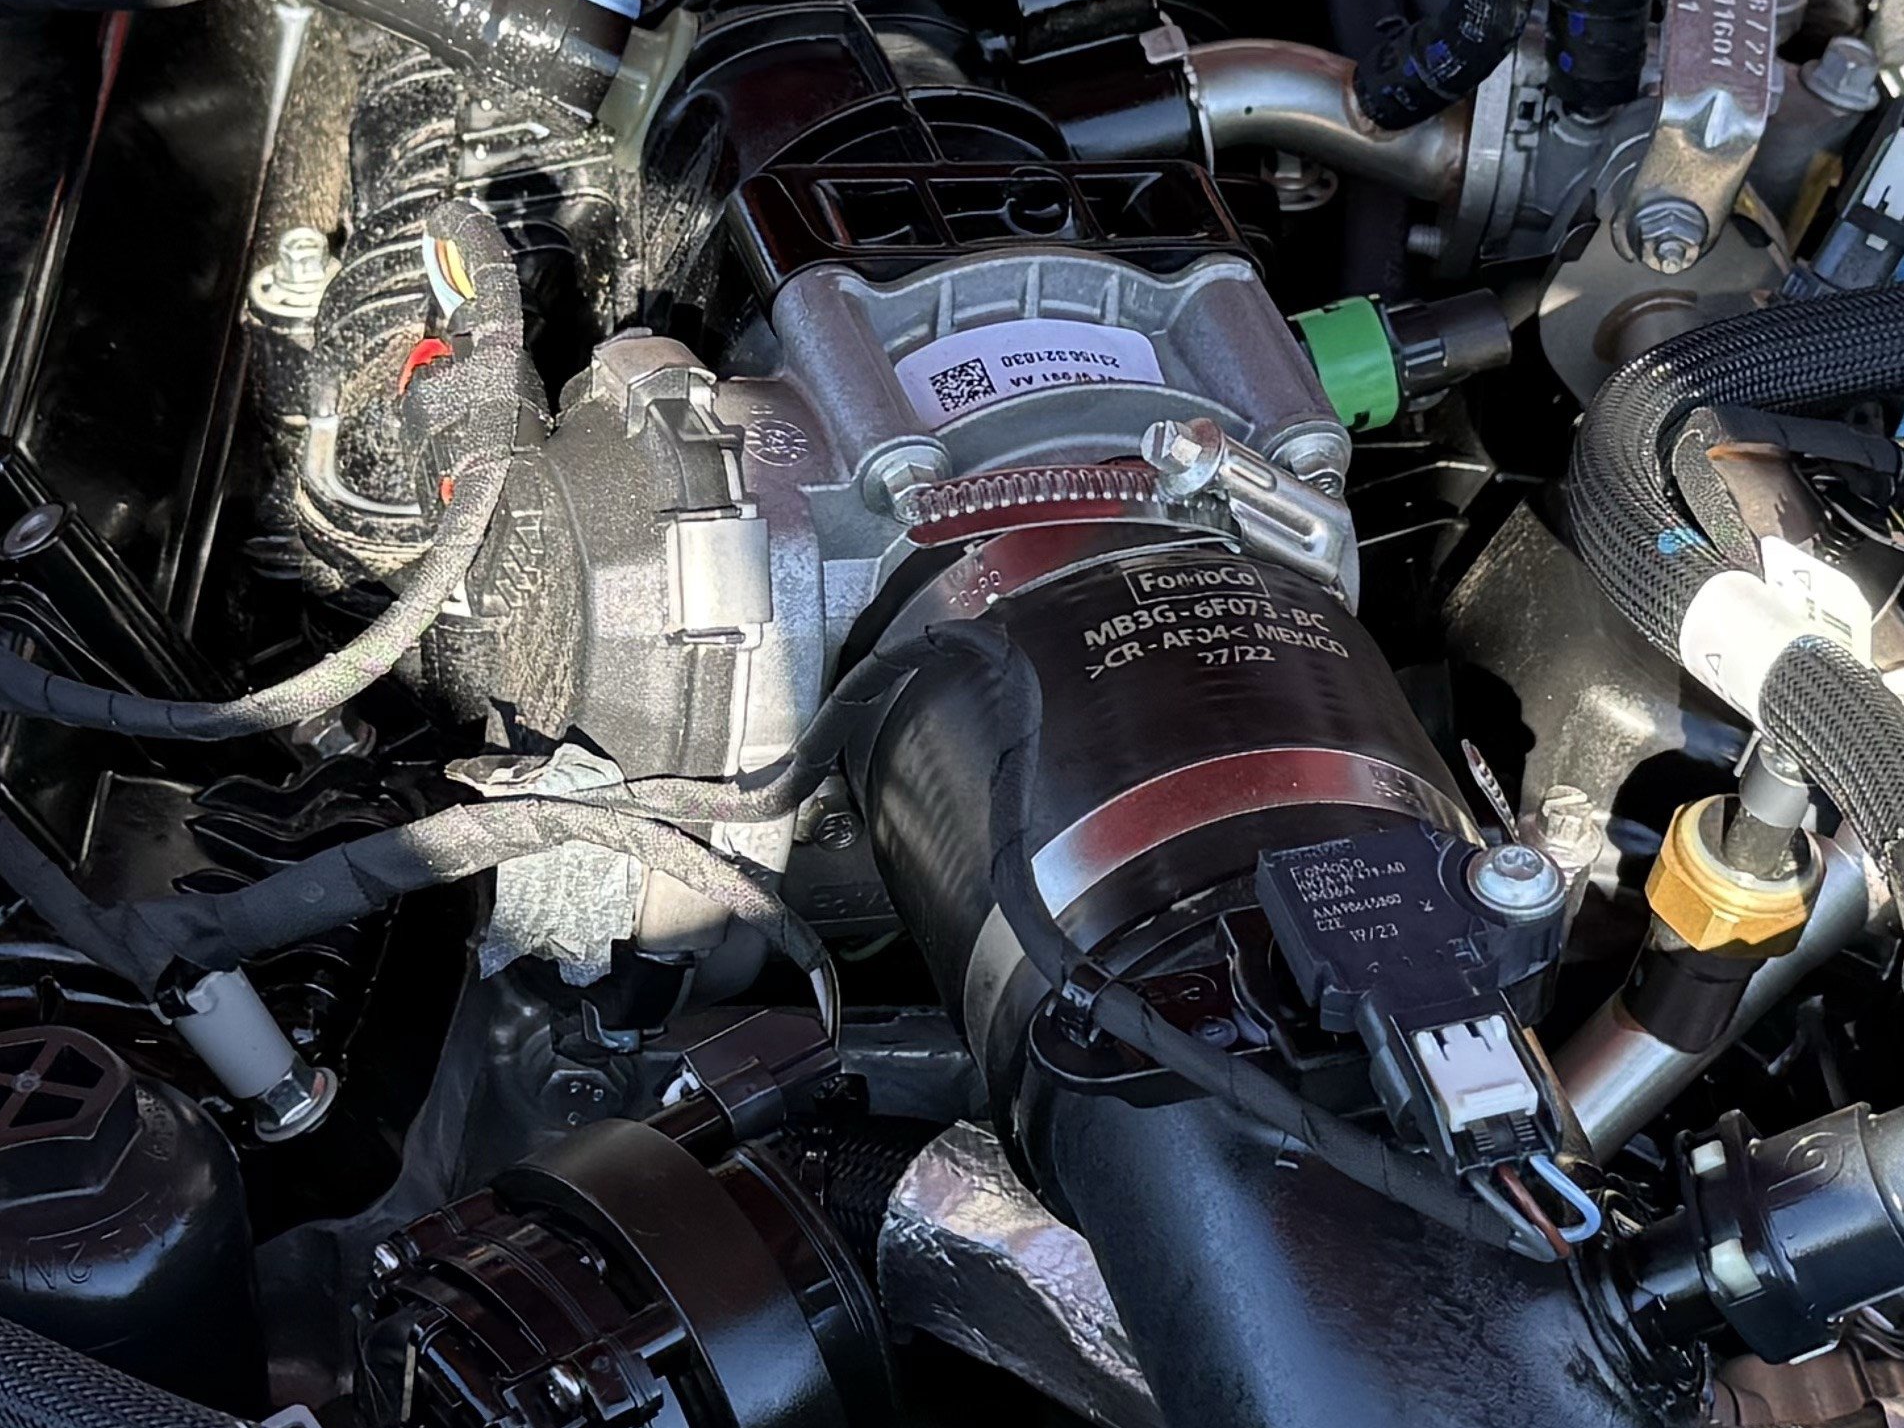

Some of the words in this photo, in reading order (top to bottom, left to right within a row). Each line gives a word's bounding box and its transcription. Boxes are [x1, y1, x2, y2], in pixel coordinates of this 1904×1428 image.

[1140, 566, 1257, 593] FoMoCo
[1257, 623, 1350, 660] MEXICO
[1348, 923, 1399, 943] 19/23
